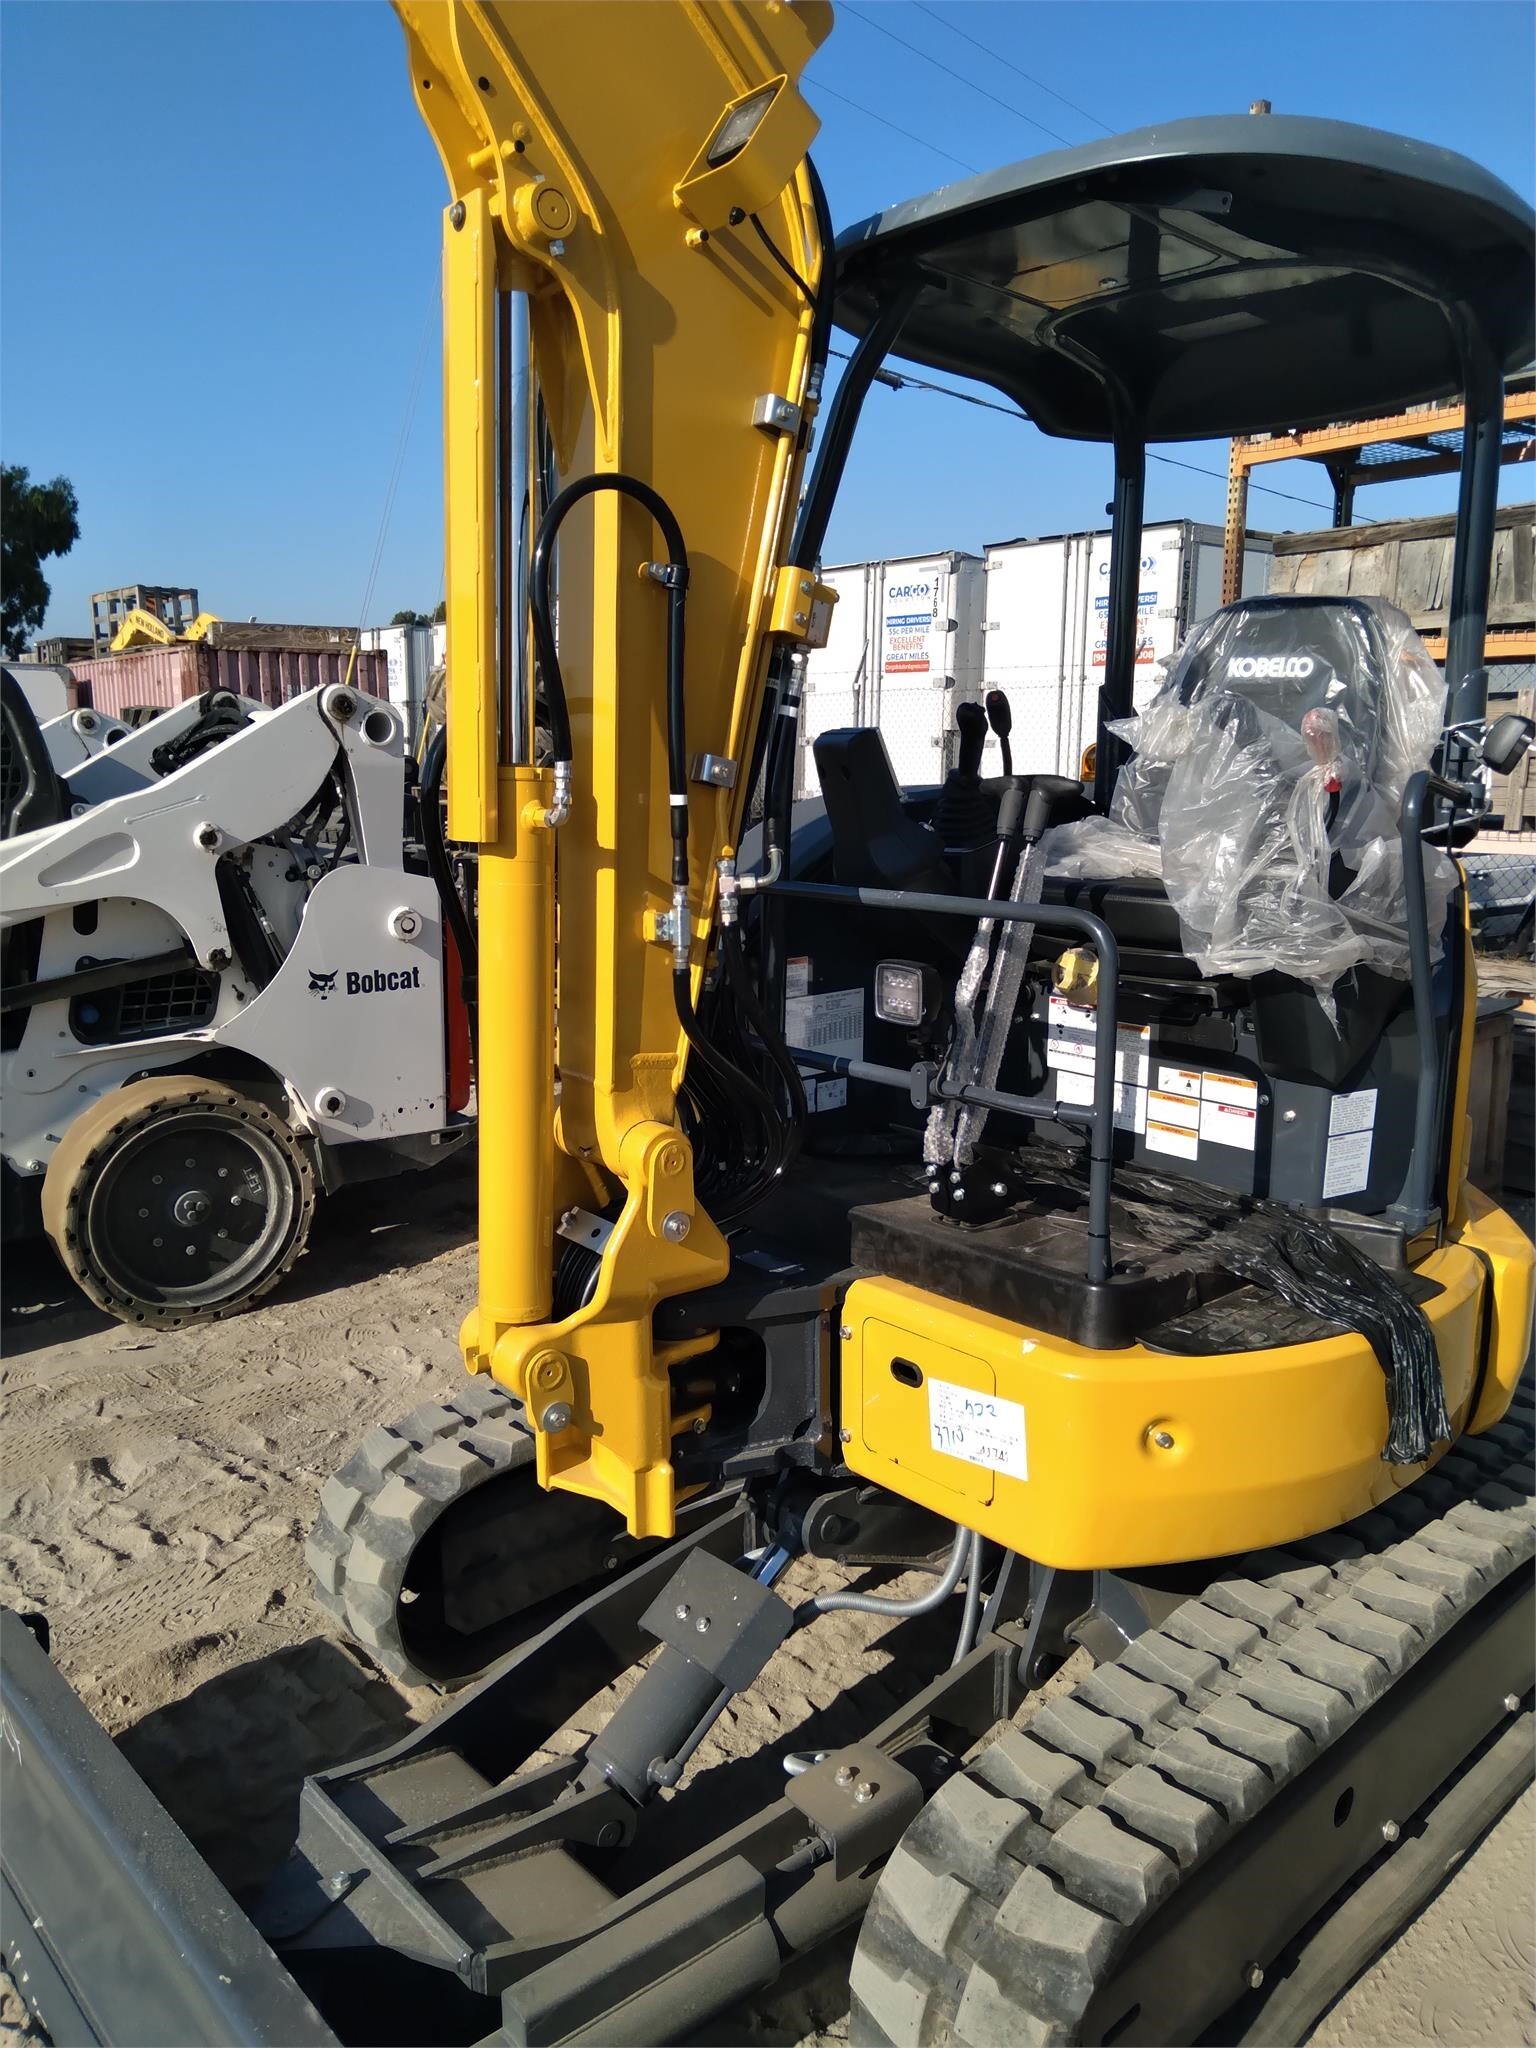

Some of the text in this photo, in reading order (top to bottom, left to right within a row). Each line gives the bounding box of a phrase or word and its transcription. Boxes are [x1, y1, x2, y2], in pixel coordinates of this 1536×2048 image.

[889, 584, 931, 598] CARGO
[915, 626, 930, 634] MILE
[889, 635, 926, 645] EXCELLENT
[892, 642, 924, 651] BENEFITS
[886, 652, 929, 661] GREAT MILES
[1227, 656, 1314, 678] KOBELCO
[346, 966, 420, 995] Bobcat
[243, 1167, 262, 1194] LEFT
